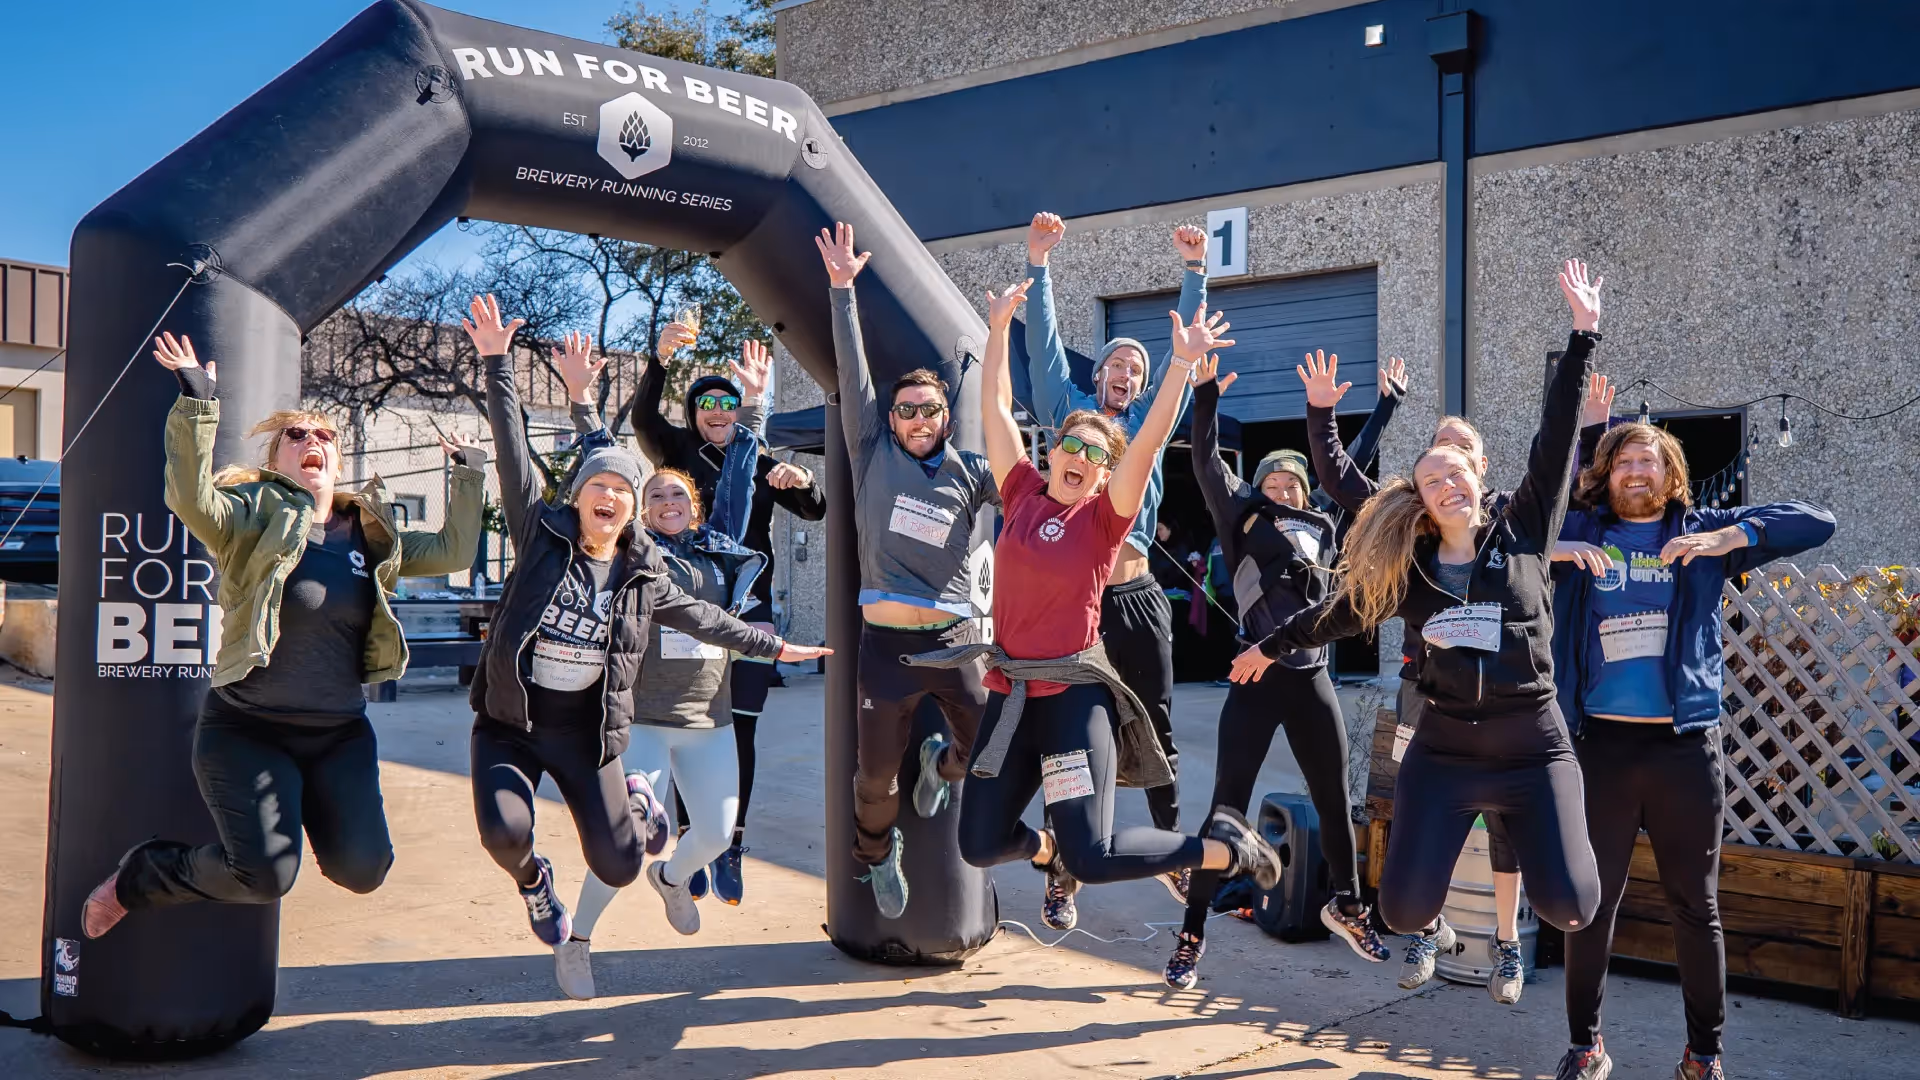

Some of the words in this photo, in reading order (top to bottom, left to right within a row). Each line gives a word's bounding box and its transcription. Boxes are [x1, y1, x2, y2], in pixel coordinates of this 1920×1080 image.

[452, 47, 564, 81] RUN
[573, 53, 672, 94] FOR
[682, 75, 798, 143] BEER
[563, 112, 587, 127] EST
[683, 135, 709, 149] 2012
[515, 166, 599, 191] BREWERY
[600, 179, 677, 203] RUNNING
[679, 192, 733, 211] SERIES
[1213, 219, 1232, 267] 1
[101, 512, 191, 554] RU
[101, 558, 215, 600] FOR
[97, 602, 224, 665] BE
[98, 665, 173, 678] BREWERY
[56, 973, 77, 986] RHINO
[56, 981, 75, 995] ARCH
